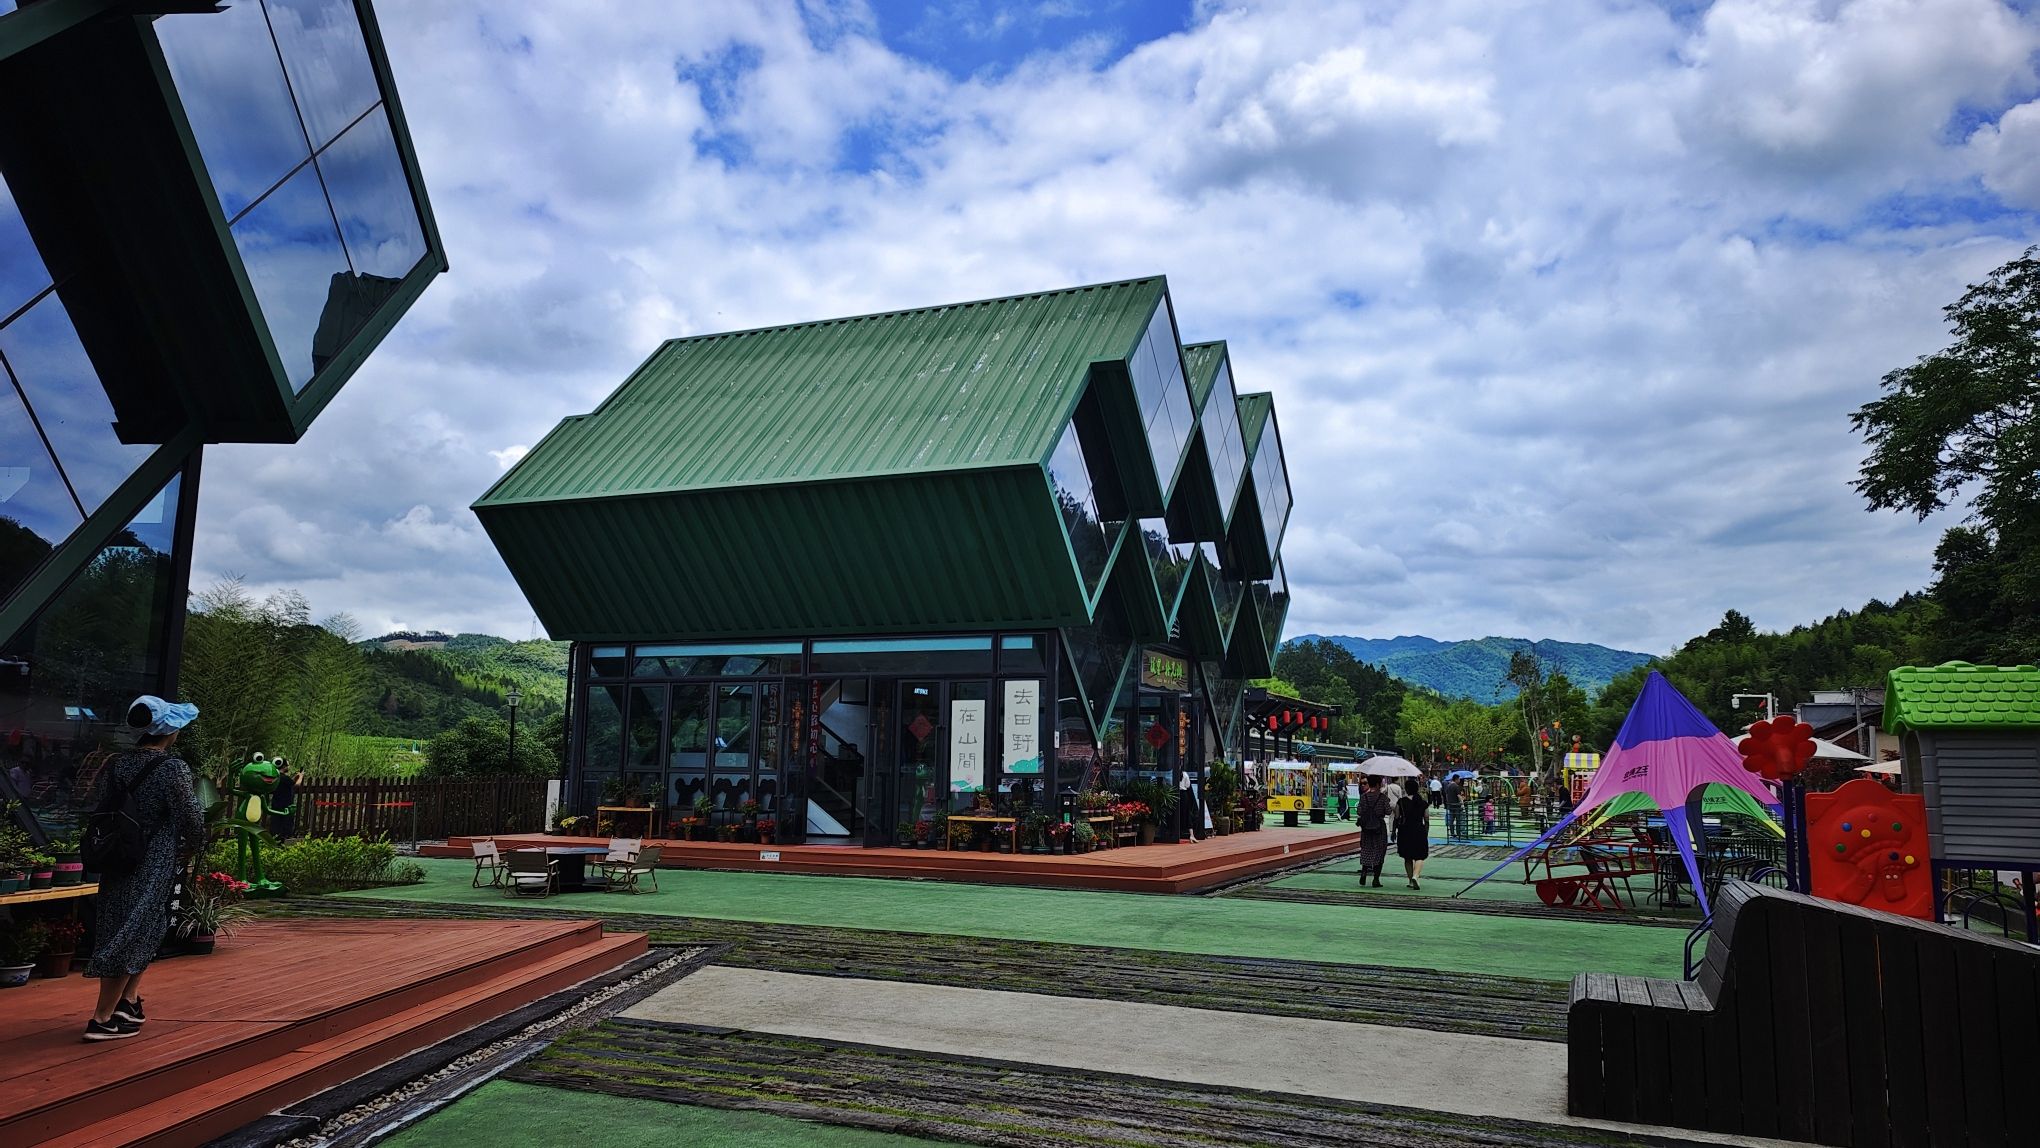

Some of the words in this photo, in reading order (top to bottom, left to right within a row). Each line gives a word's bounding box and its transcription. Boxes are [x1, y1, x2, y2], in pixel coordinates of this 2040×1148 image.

[958, 707, 978, 771] 在山間
[1012, 688, 1034, 753] 去田野
